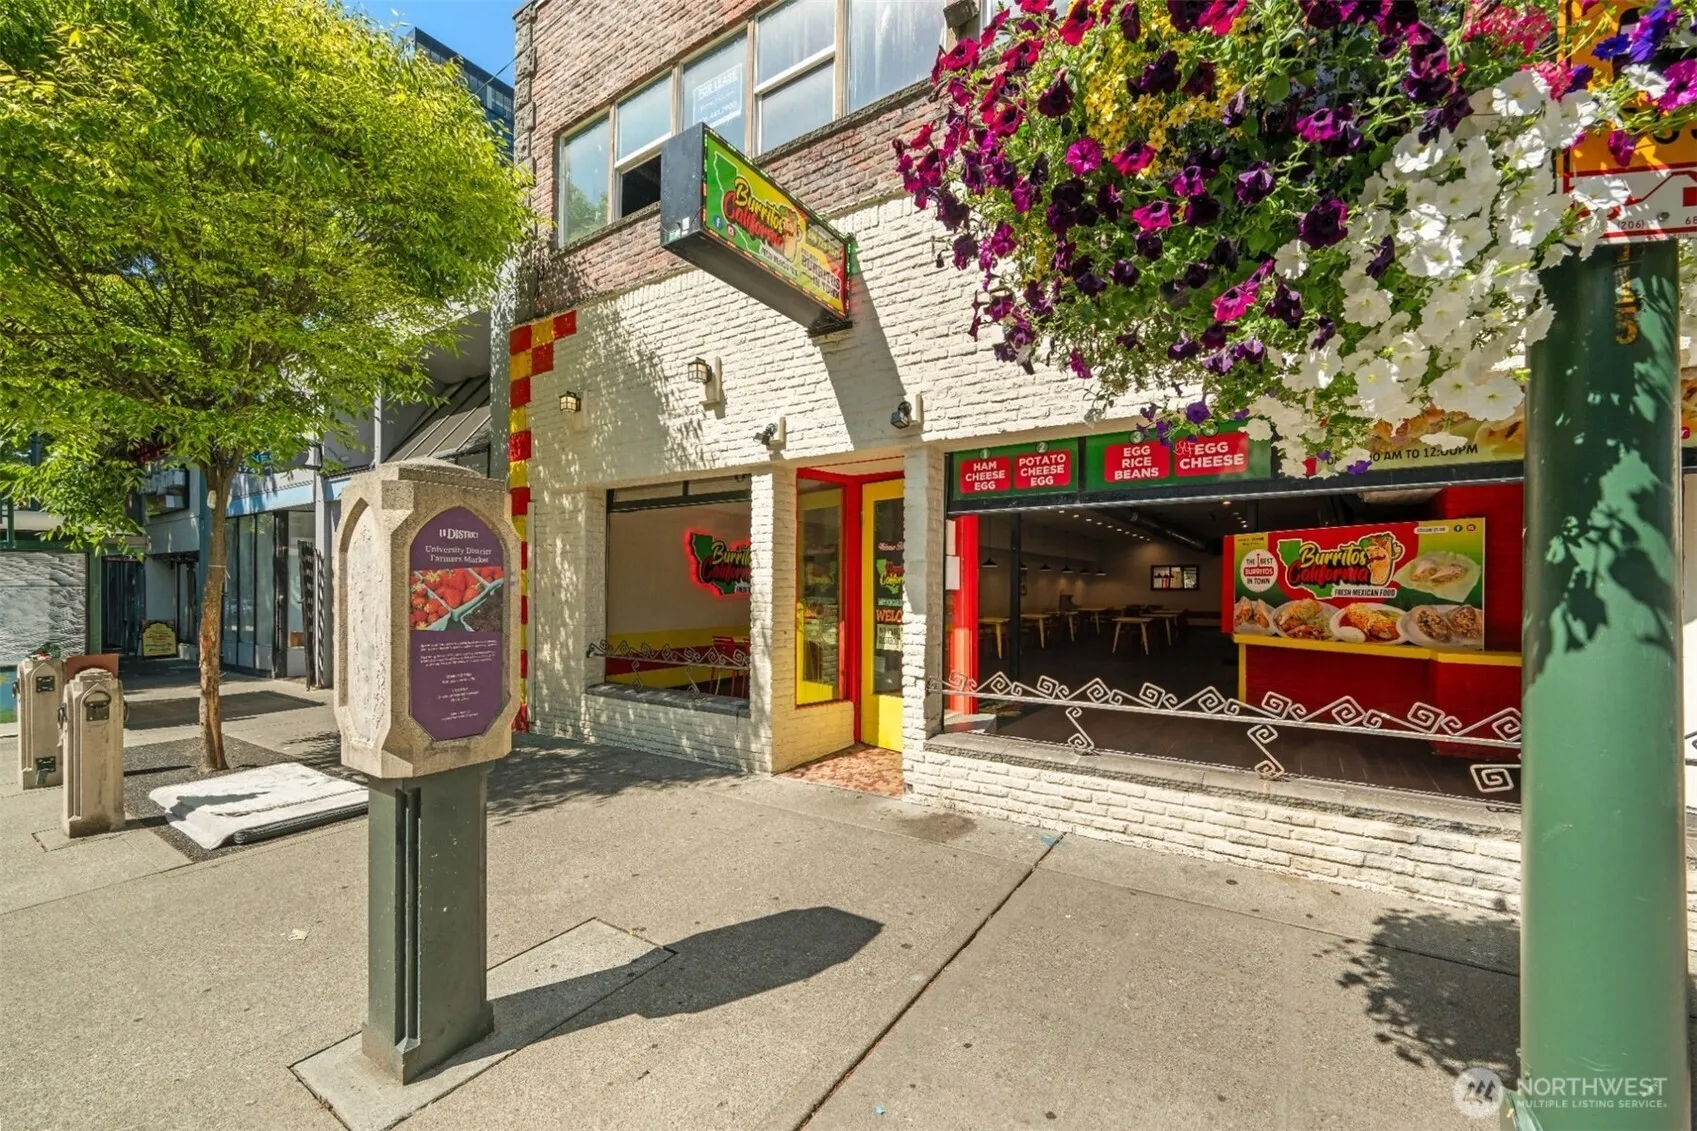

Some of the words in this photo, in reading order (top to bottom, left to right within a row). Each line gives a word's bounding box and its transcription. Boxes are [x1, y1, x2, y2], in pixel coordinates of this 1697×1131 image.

[713, 68, 738, 89] LEASE
[734, 176, 784, 235] Burritos
[723, 190, 785, 250] California
[1617, 219, 1645, 230] (206)
[1133, 431, 1141, 443] 3
[1039, 442, 1046, 453] 2
[1123, 445, 1150, 457] EGG
[1194, 441, 1229, 455] EGG
[1018, 453, 1066, 467] POTATO
[1383, 450, 1402, 460] AM
[1406, 448, 1420, 459] TO
[973, 461, 997, 472] HAM
[1121, 456, 1152, 469] RICE
[1179, 453, 1244, 470] CHEESE
[965, 470, 1006, 482] CHEESE
[1020, 464, 1065, 477] CHEESE
[1114, 467, 1160, 480] BEANS
[974, 481, 996, 491] EGG
[1030, 476, 1054, 487] EGG
[425, 545, 465, 556] University
[466, 547, 492, 555] District
[711, 541, 751, 566] Burrit
[1299, 543, 1367, 568] Burritos
[430, 554, 462, 563] Farmers
[464, 556, 489, 564] Market
[1260, 557, 1274, 565] BEST
[1288, 560, 1370, 586] California
[1334, 588, 1352, 597] FRESH
[1352, 588, 1379, 597] MEXICAN
[1379, 588, 1396, 597] FOOD
[876, 609, 903, 623] WELC
